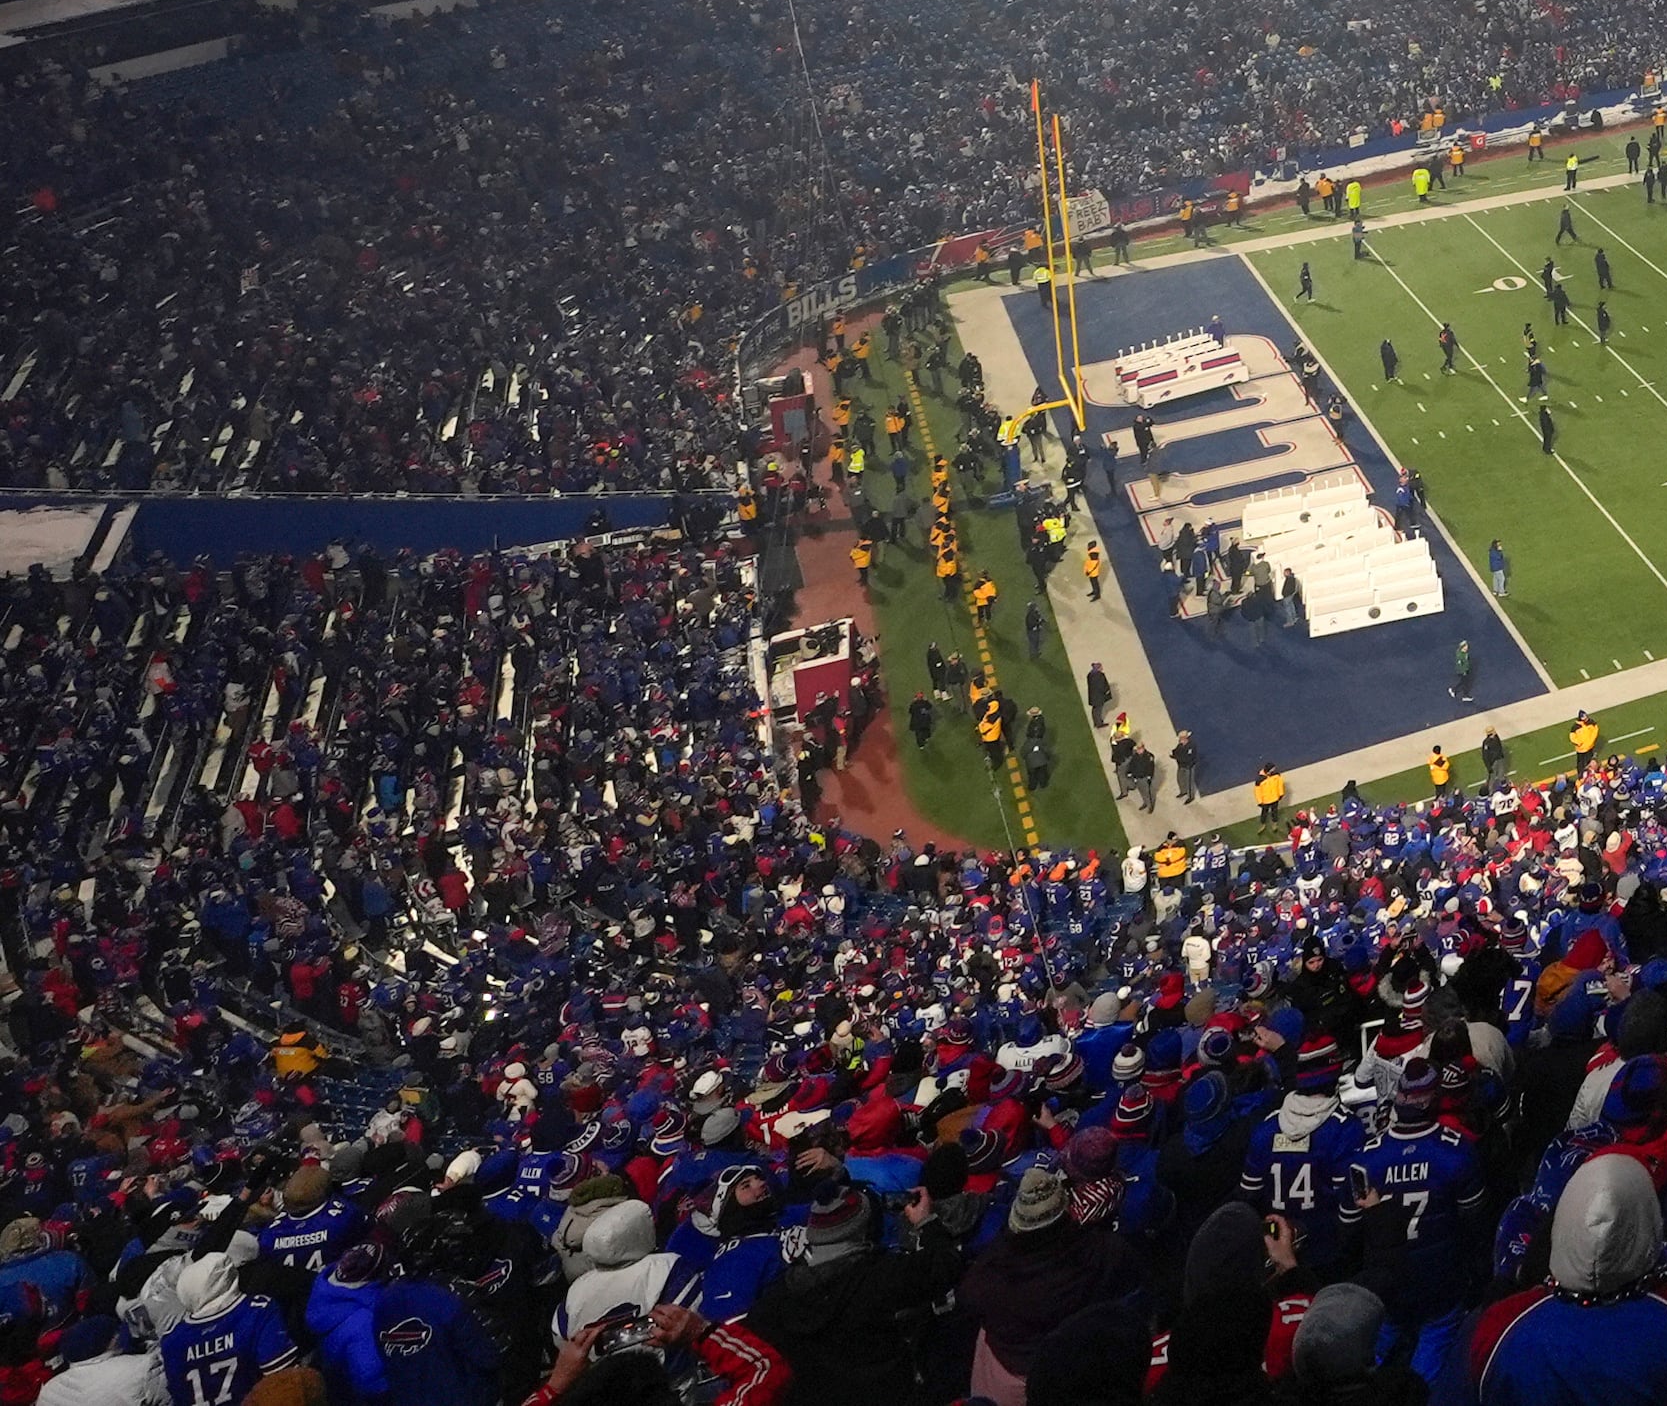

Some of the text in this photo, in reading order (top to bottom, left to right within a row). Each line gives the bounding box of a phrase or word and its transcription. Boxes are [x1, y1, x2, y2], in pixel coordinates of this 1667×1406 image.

[1384, 833, 1400, 845] 82
[1441, 938, 1454, 949] 17
[1247, 953, 1258, 964] 17
[1123, 966, 1134, 977] 17
[1500, 978, 1532, 1022] 7
[537, 1072, 554, 1084] 58
[72, 1171, 87, 1186] 17
[520, 1166, 542, 1178] ALLEN
[1385, 1161, 1429, 1186] ALLEN
[1269, 1161, 1316, 1211] 14
[273, 1229, 328, 1250] ANDREESSEN
[1281, 1297, 1311, 1326] 17
[186, 1332, 234, 1362] ALLEN
[185, 1356, 238, 1406] 17
